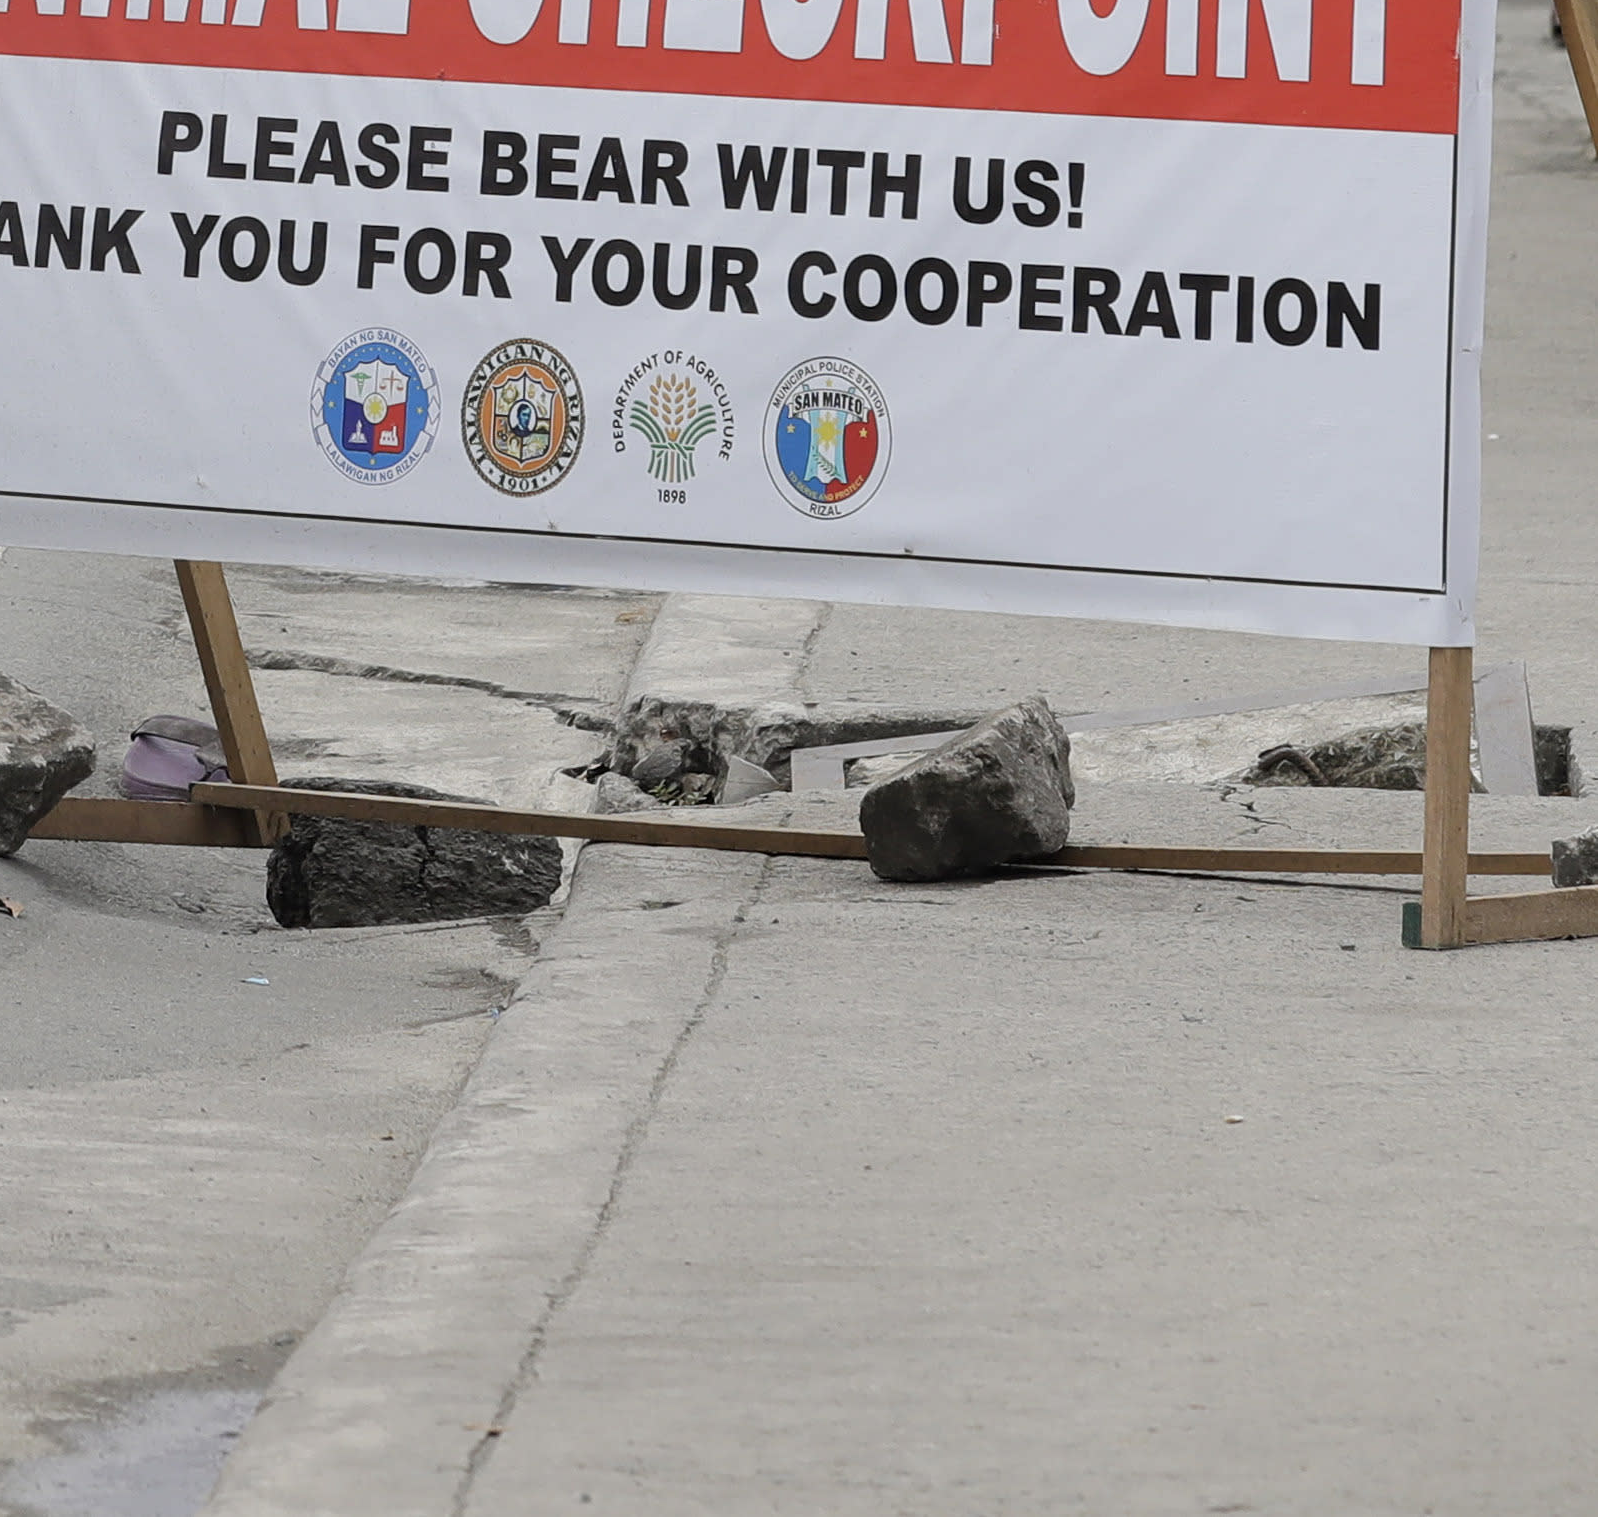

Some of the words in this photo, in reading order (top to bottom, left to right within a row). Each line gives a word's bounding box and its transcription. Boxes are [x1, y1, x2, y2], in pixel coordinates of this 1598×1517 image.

[157, 110, 453, 193] PLEASE
[480, 130, 690, 207] BEAR
[717, 143, 922, 220] WITH
[952, 156, 1085, 228] US!
[170, 212, 328, 287] YOU
[357, 224, 512, 299] FOR
[540, 235, 759, 315] YOUR
[787, 250, 1381, 351] COOPERATION
[327, 336, 358, 368] BAYAN
[359, 330, 375, 341] NG
[377, 330, 398, 343] SAN
[398, 339, 427, 374] MATEO
[548, 355, 572, 386] NG
[466, 344, 545, 464] LALAWIGAN
[612, 353, 659, 453] DEPARTMENT
[663, 350, 684, 364] OF
[686, 354, 735, 462] AGRICULTURE
[772, 363, 818, 409] MUNICIPAL
[819, 361, 856, 380] POLICE
[855, 373, 885, 418] STATION
[794, 392, 820, 411] SAN
[822, 392, 863, 415] MATEO
[549, 393, 581, 475] RIZAL
[326, 441, 378, 482] LALAWIGAN
[380, 472, 394, 482] NG
[396, 450, 421, 475] RIZAL
[498, 475, 540, 492] 1901
[657, 489, 687, 504] 1898
[809, 503, 842, 516] RIZAL
